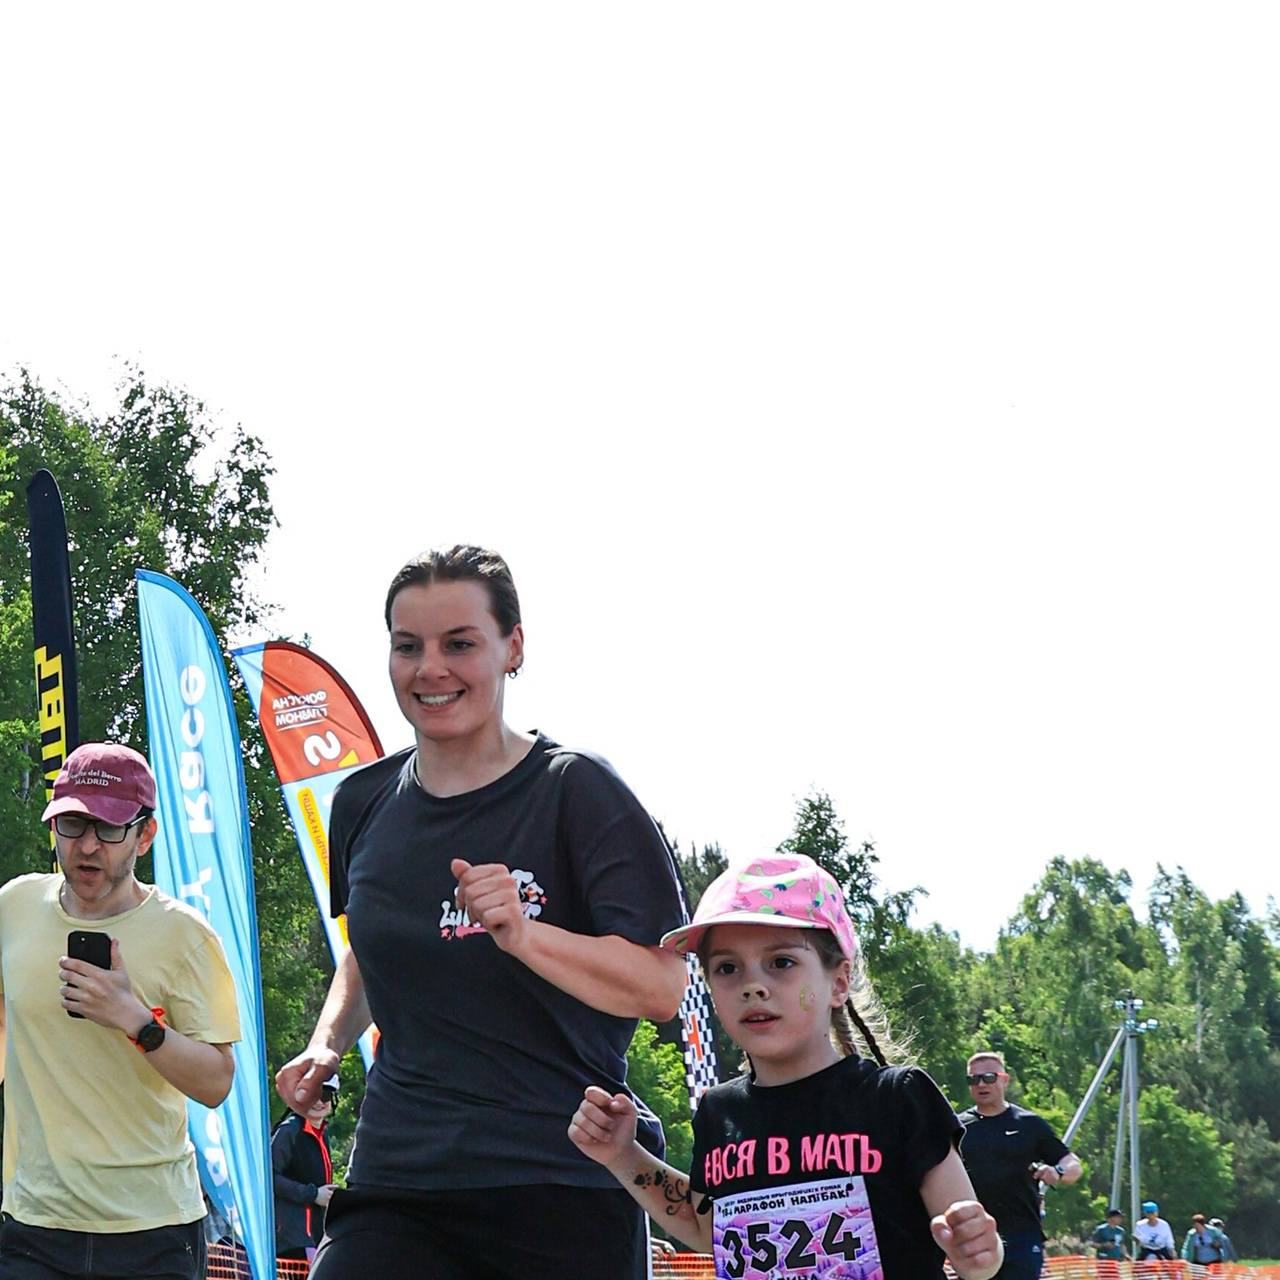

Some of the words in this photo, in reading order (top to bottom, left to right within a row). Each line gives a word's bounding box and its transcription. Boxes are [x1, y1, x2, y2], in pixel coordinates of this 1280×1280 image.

[74, 777, 109, 787] MADRID
[87, 769, 100, 777] del
[767, 1136, 791, 1175] В
[801, 1133, 883, 1174] МАТЬ
[733, 1197, 786, 1217] МАРАФОН
[791, 1189, 850, 1208] НАЛІБАКІ
[721, 1212, 863, 1279] 3524
